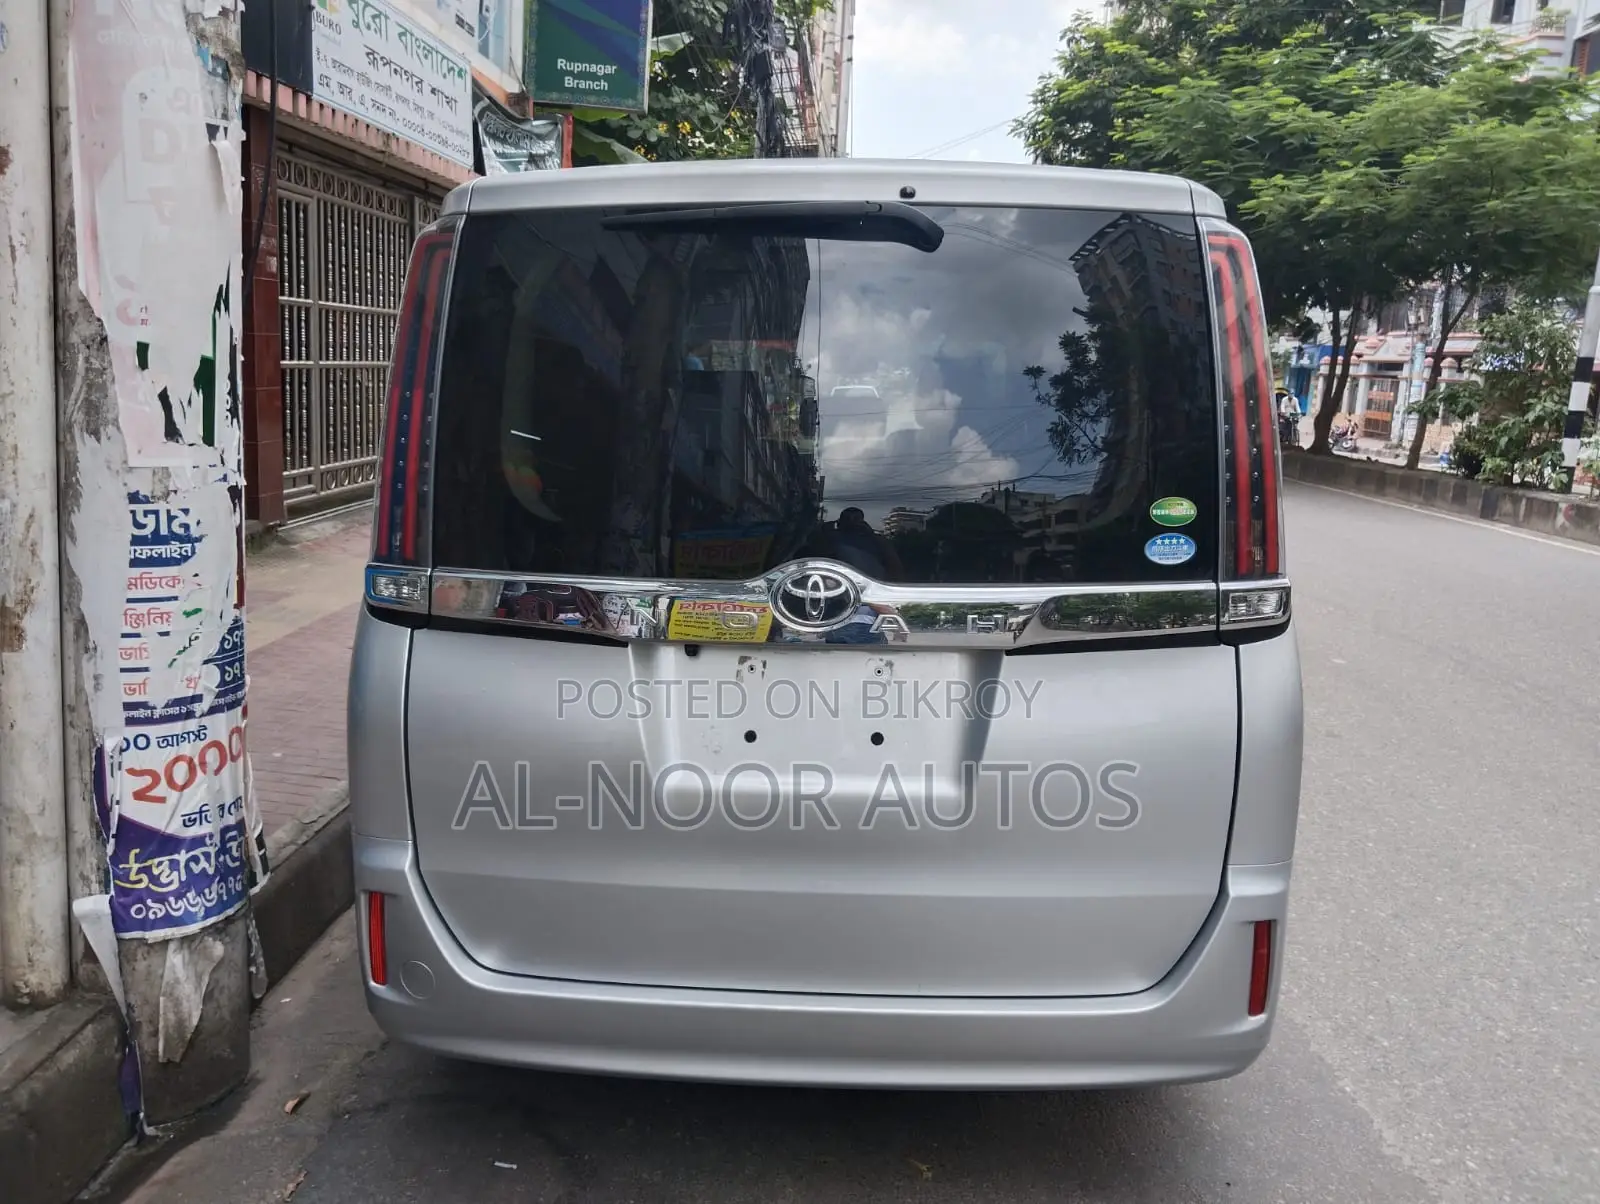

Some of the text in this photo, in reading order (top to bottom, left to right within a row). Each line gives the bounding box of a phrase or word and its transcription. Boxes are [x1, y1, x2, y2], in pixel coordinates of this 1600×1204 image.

[315, 11, 342, 35] BURO
[395, 20, 469, 92] বাংলাদেশ
[557, 58, 617, 76] Rupnagar
[363, 44, 424, 97] রূপনগর
[428, 83, 459, 116] শাখা
[564, 76, 608, 91] Branch
[155, 724, 208, 749] আগস্ট
